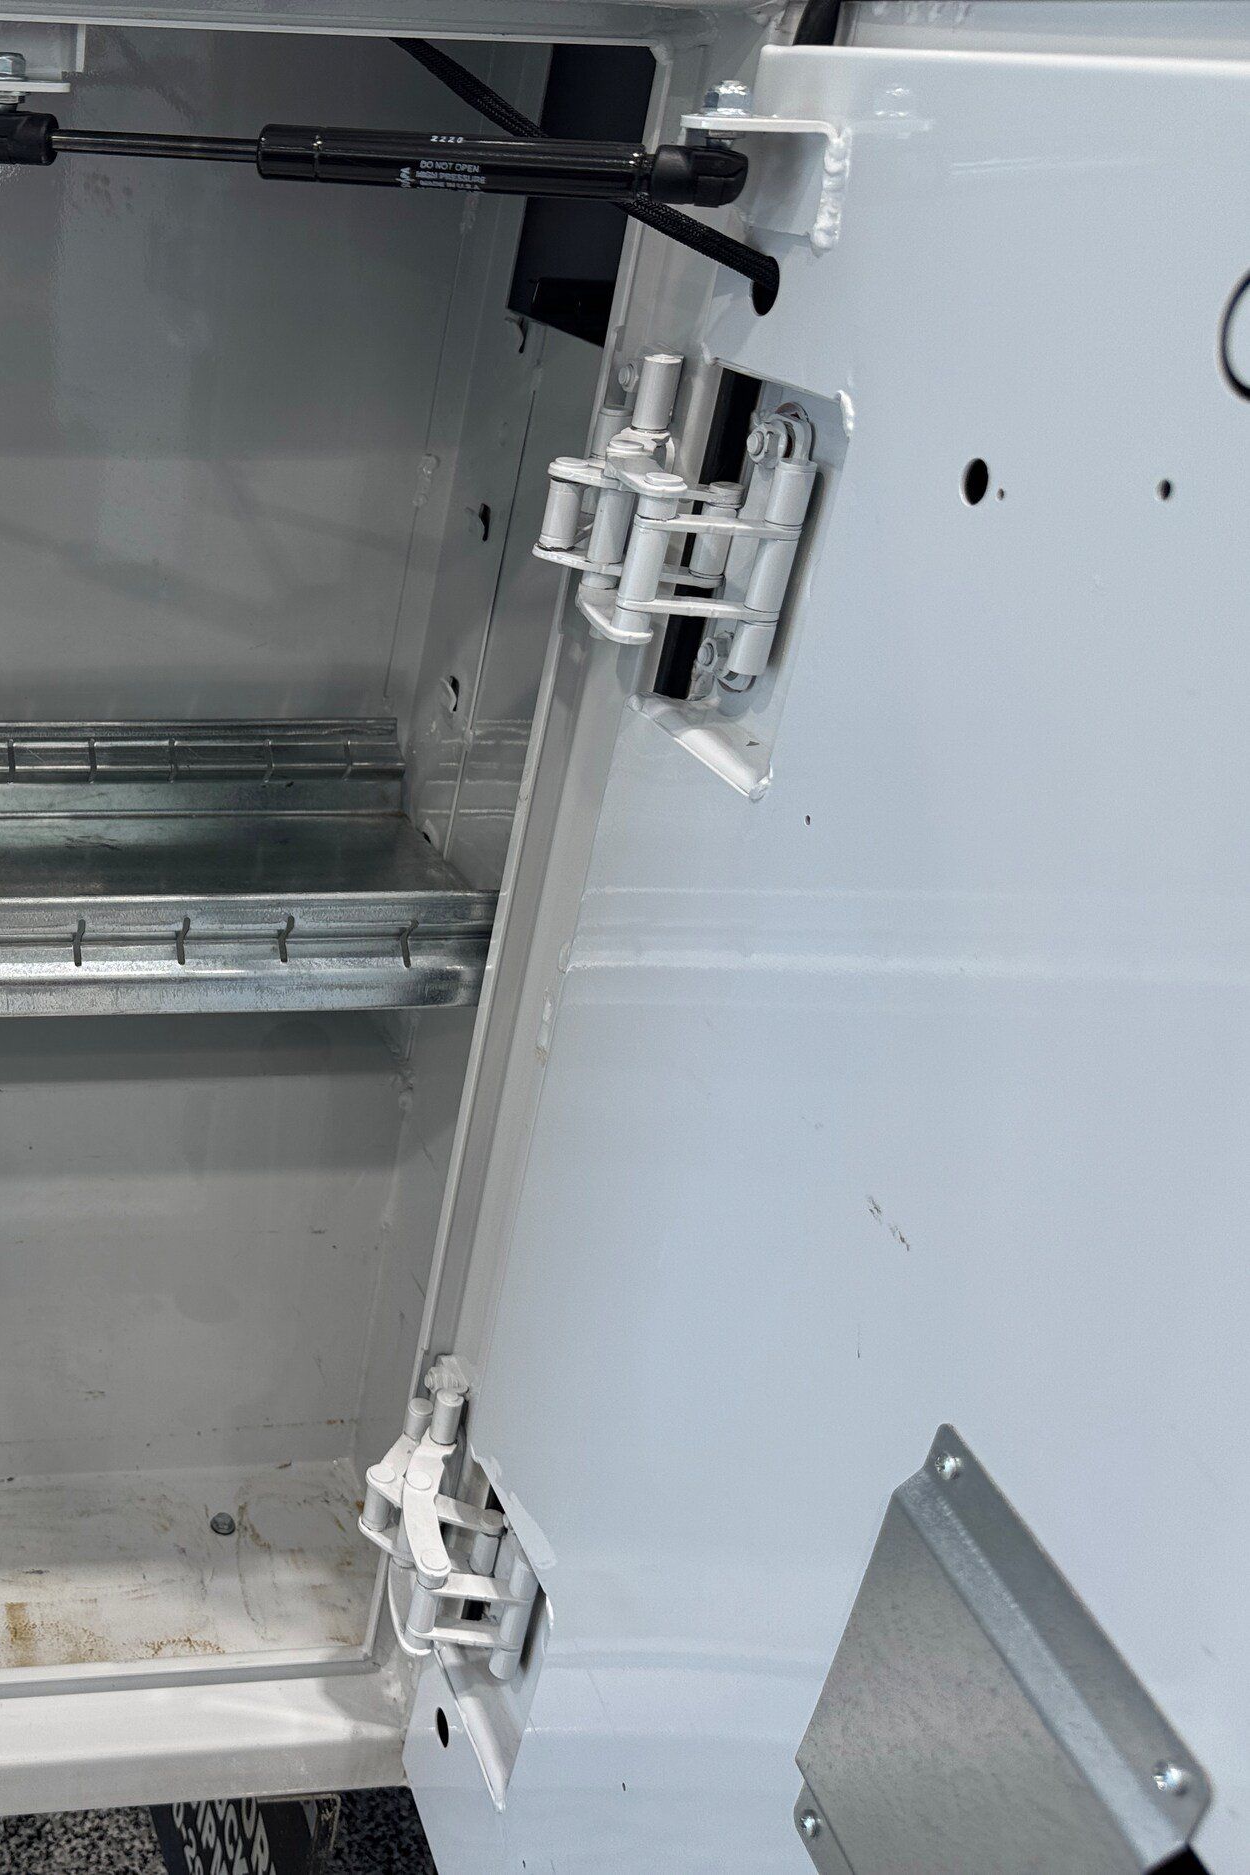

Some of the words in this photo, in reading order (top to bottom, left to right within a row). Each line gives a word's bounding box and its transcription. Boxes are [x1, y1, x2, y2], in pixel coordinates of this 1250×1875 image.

[430, 135, 464, 143] 2220
[420, 160, 434, 169] DO
[435, 161, 454, 171] NOT
[455, 163, 480, 173] OPEN
[416, 171, 438, 179] HIGH
[438, 172, 486, 184] PRESSURE
